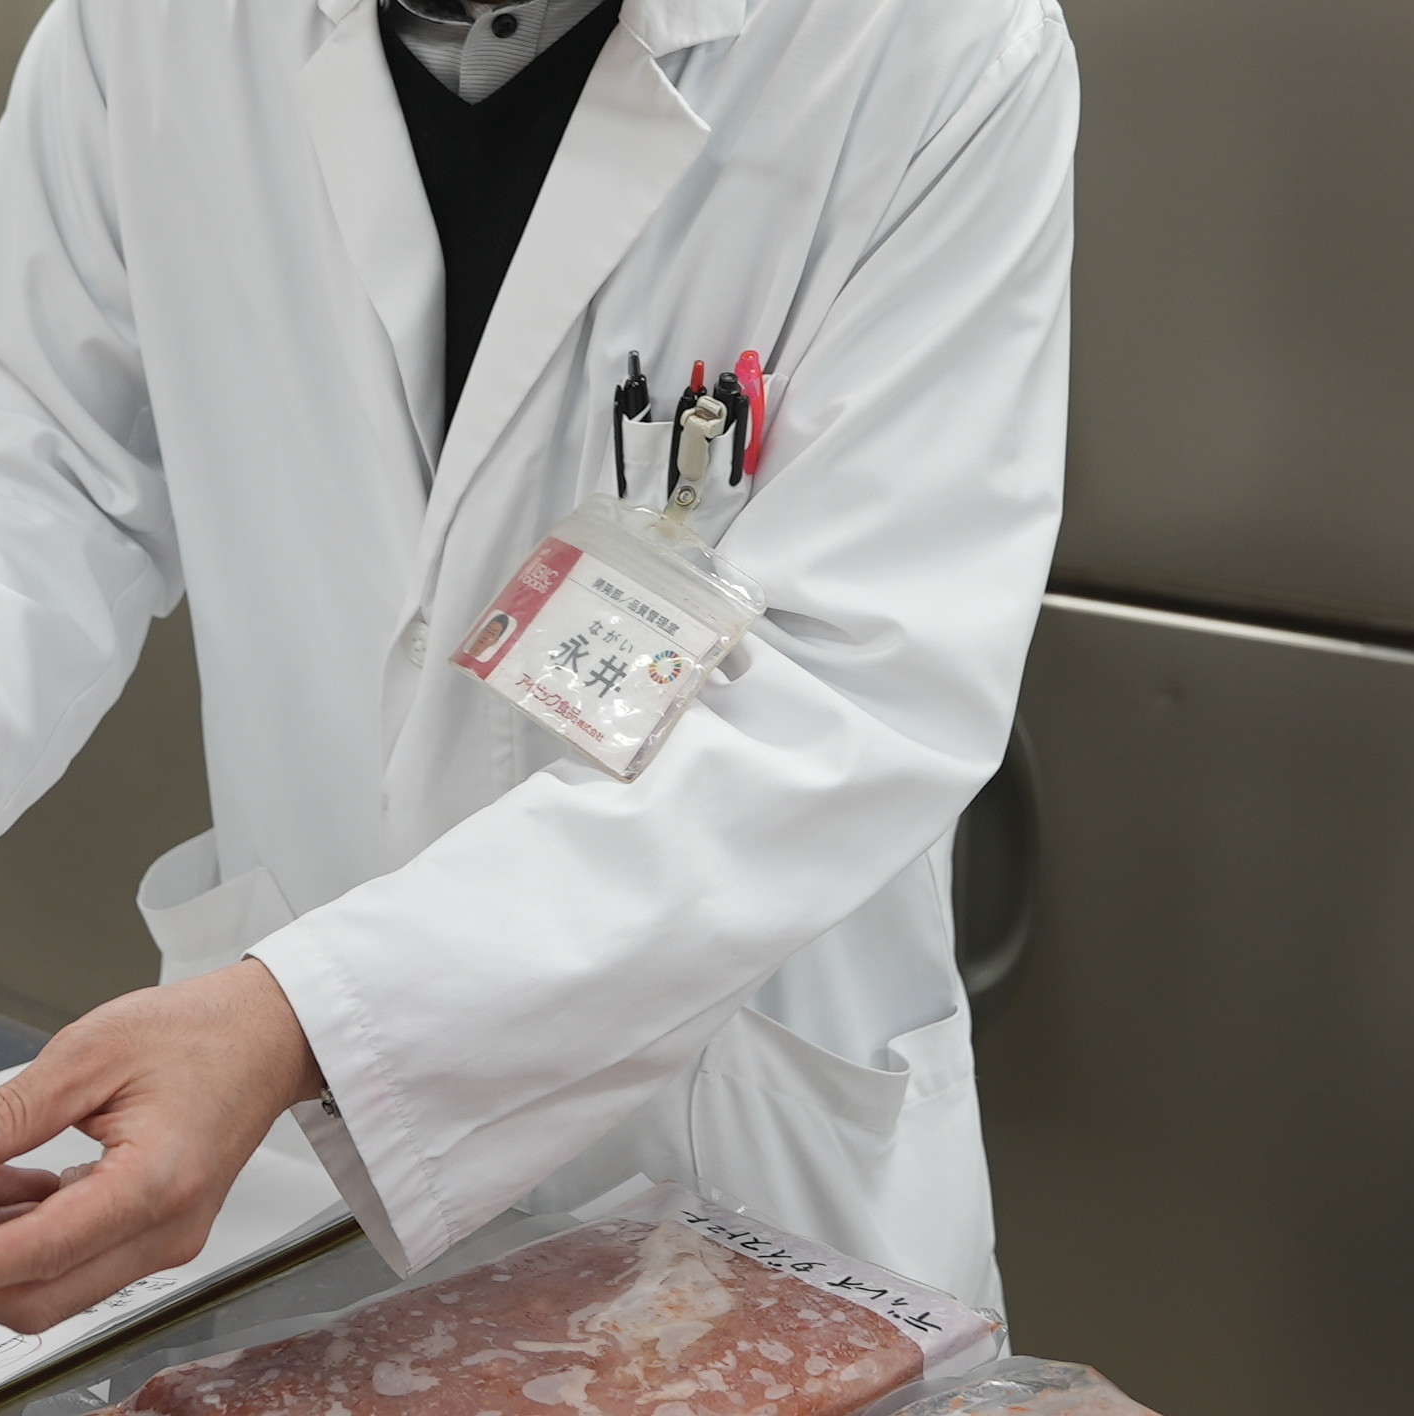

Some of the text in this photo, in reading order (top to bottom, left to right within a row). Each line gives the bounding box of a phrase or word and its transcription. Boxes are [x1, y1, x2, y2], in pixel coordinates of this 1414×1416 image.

[588, 619, 633, 655] ながい
[551, 634, 628, 699] 永井
